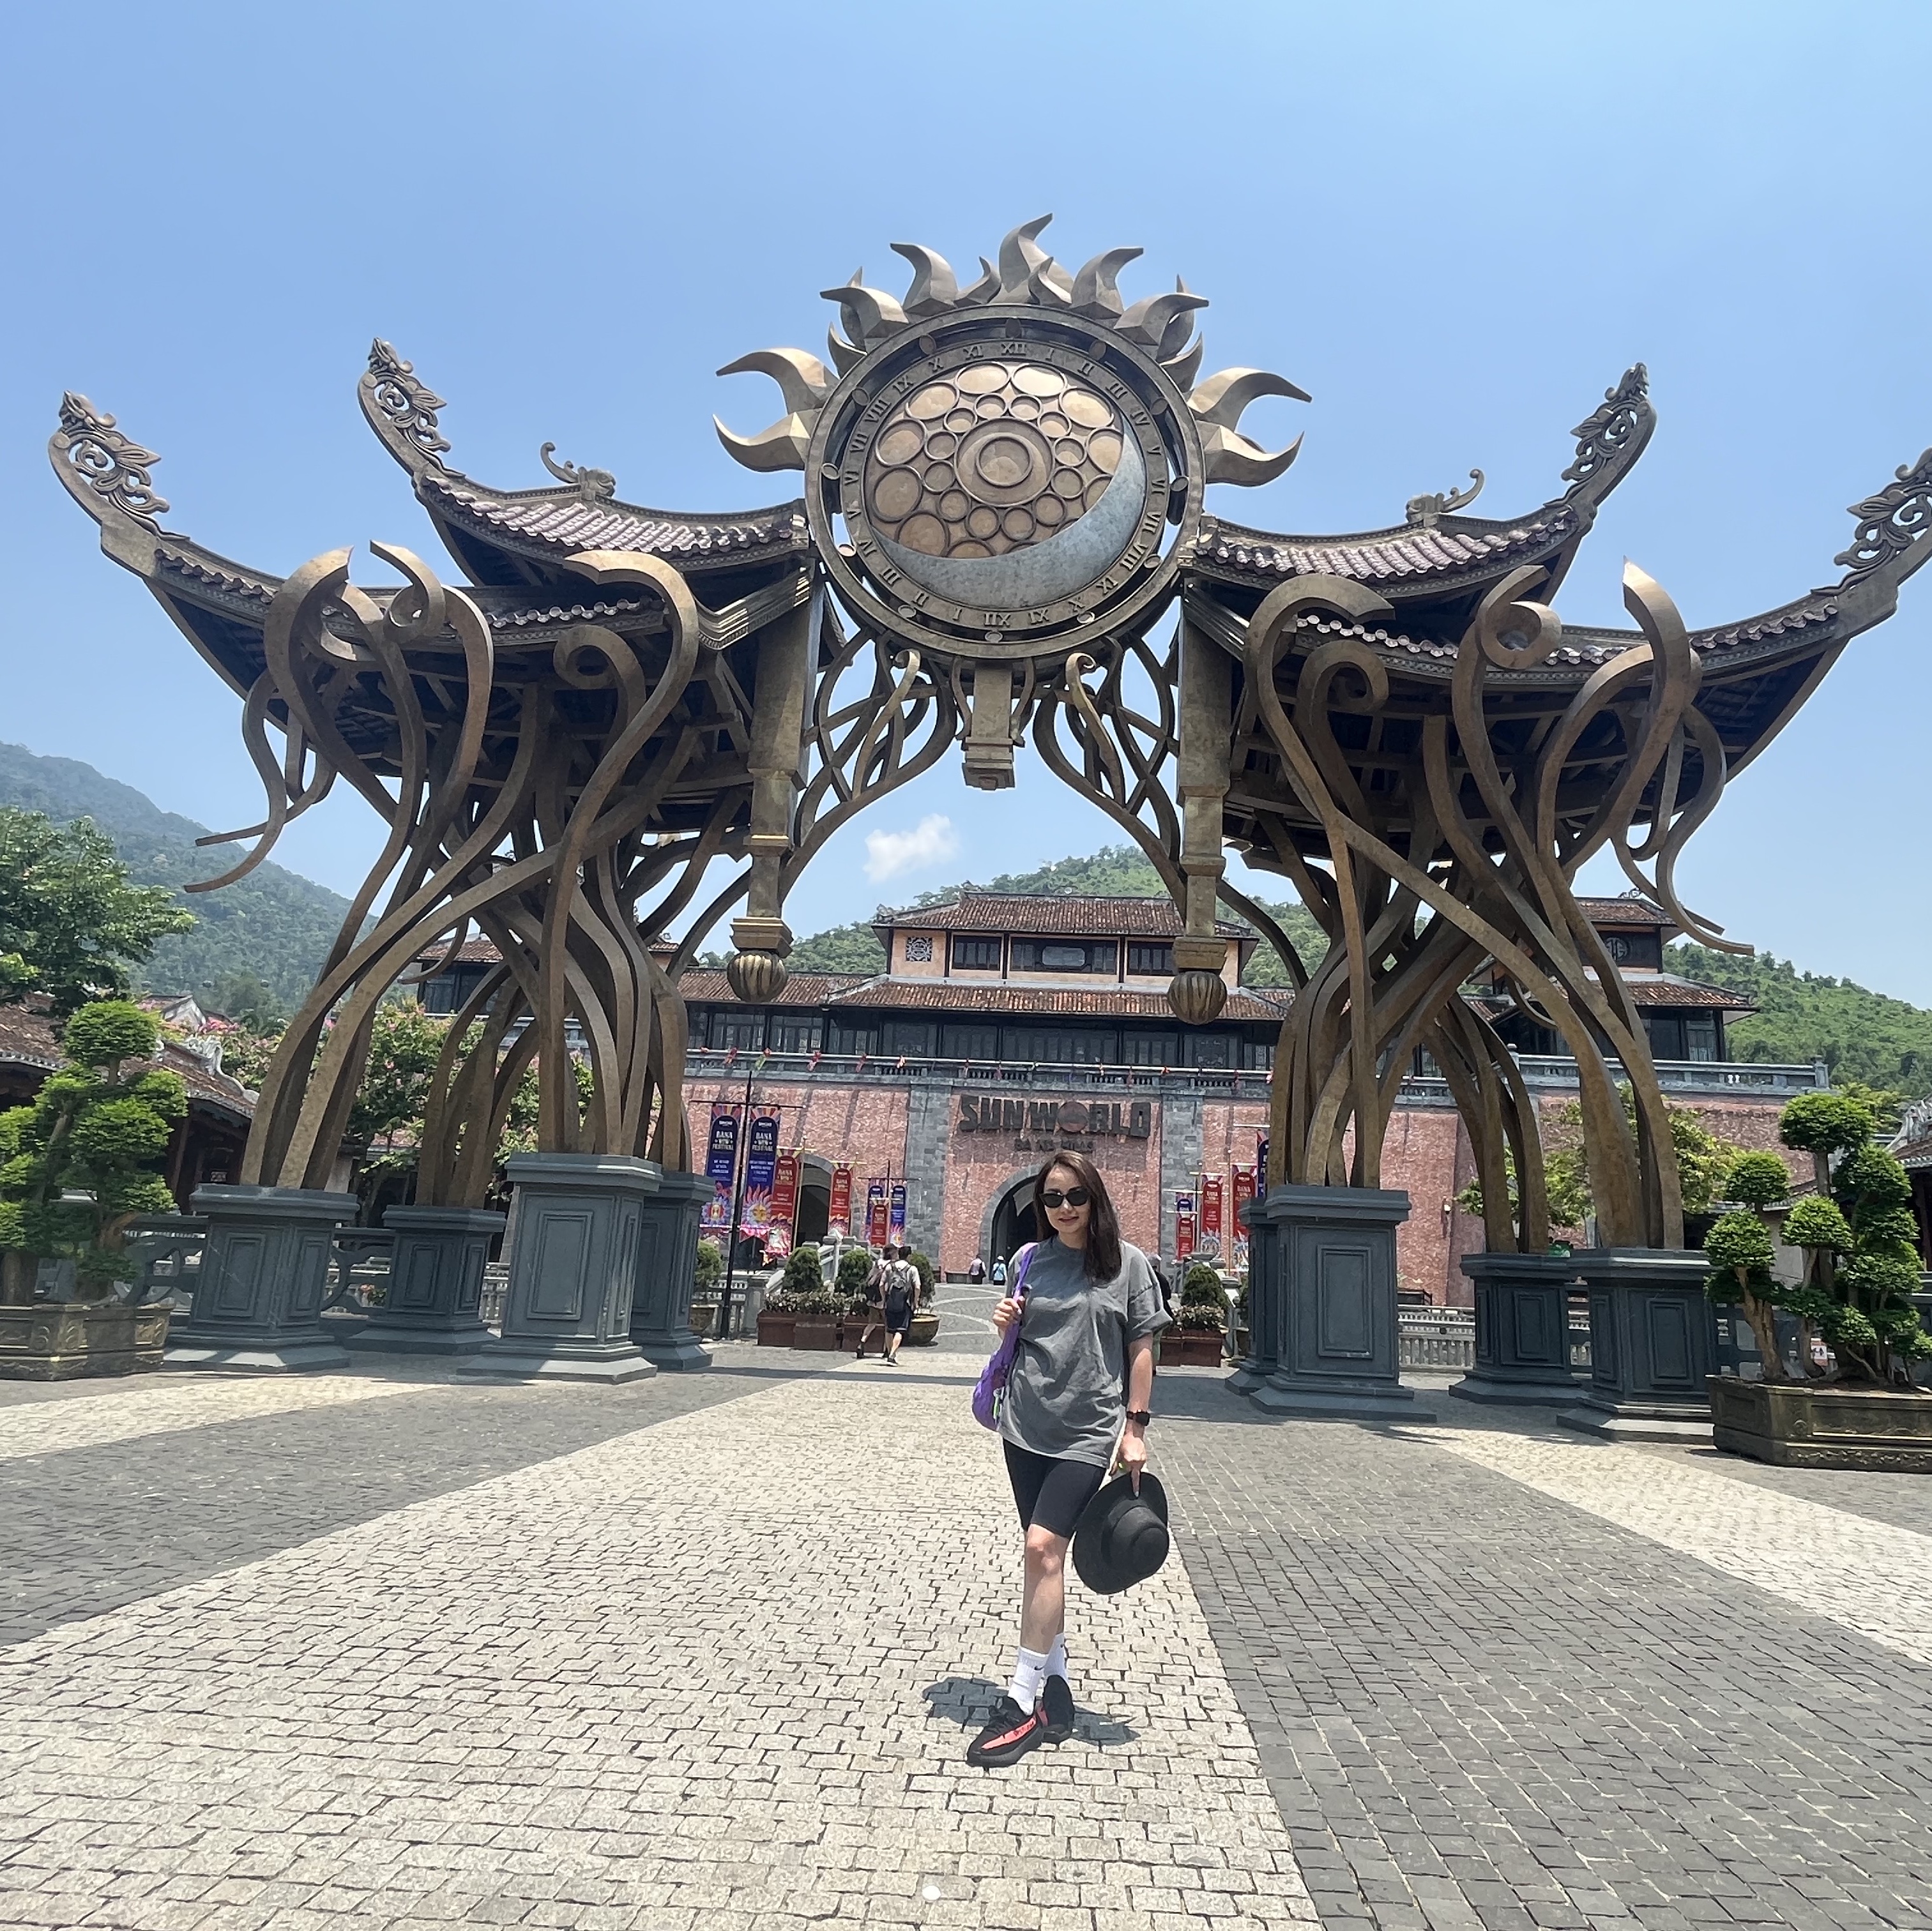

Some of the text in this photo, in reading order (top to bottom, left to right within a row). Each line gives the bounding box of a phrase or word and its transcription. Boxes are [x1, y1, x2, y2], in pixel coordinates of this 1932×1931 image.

[962, 345, 984, 361] XI
[1001, 343, 1026, 356] XII
[1045, 347, 1054, 361] I
[928, 357, 944, 372] X
[1077, 362, 1095, 377] II
[892, 375, 914, 393] IX
[1106, 382, 1128, 400] III
[864, 399, 892, 423] VIII
[1130, 411, 1150, 427] IV
[849, 433, 870, 453] VII
[844, 471, 859, 486] VI
[1152, 479, 1166, 496] VI
[1143, 511, 1162, 534] VII
[879, 568, 902, 587] III
[911, 591, 929, 607] II
[1068, 596, 1085, 613] X
